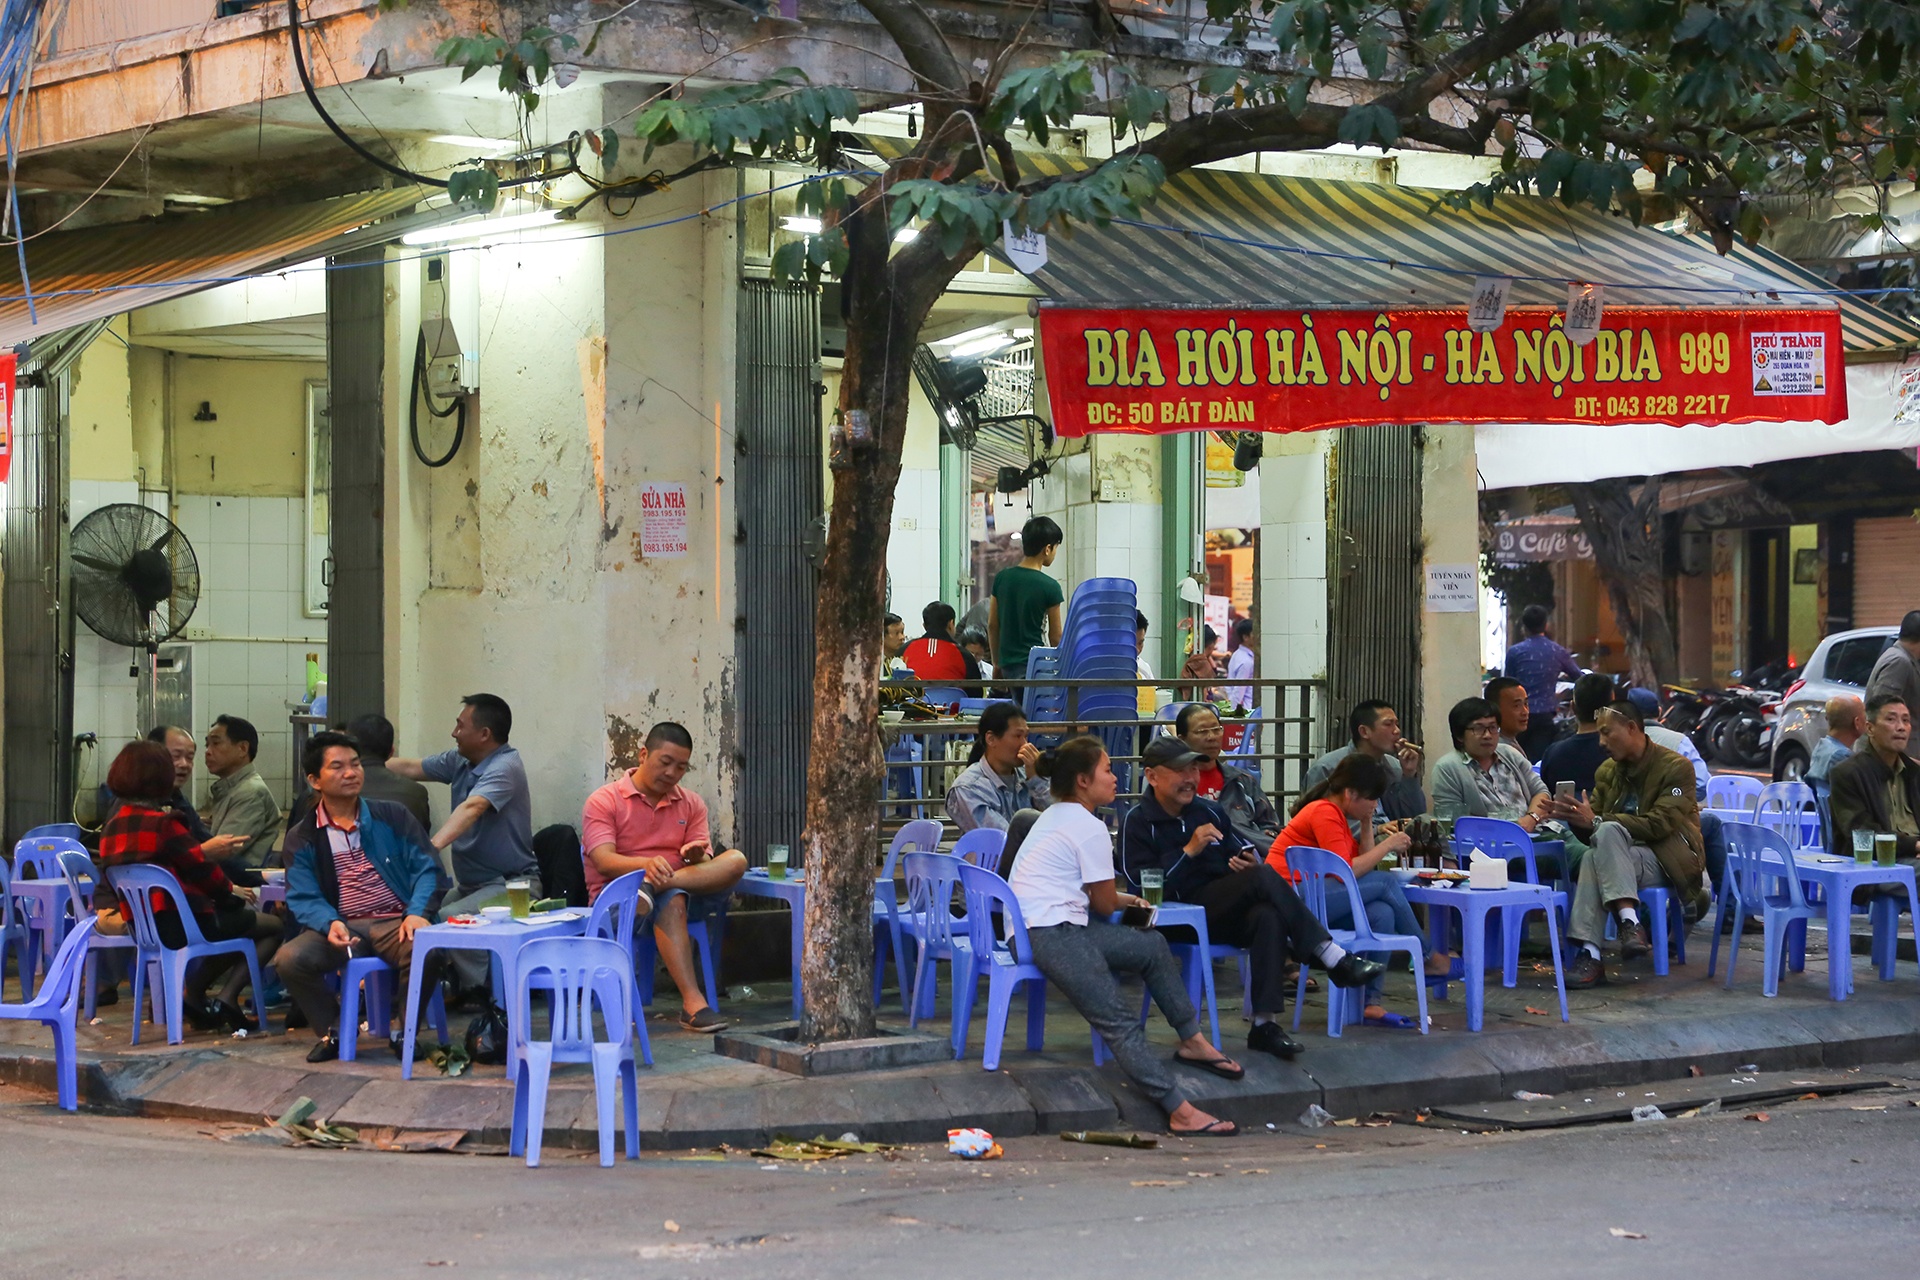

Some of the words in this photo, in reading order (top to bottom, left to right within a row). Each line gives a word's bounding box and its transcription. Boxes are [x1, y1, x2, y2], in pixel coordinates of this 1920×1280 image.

[1753, 333, 1777, 348] PHÚ
[1780, 333, 1822, 348] THÀNH
[1083, 328, 1166, 388] BIA
[1174, 318, 1257, 387] HƠI
[1265, 313, 1329, 386] HÀ
[1337, 312, 1413, 401] NỘI
[1514, 313, 1586, 399] NỘI
[1594, 328, 1662, 384] BIA
[1679, 332, 1730, 375] 989
[1087, 402, 1122, 425] ĐC:
[1128, 402, 1154, 424] 50
[1160, 397, 1202, 423] BÁT
[1208, 396, 1255, 423] ĐÀN
[1575, 398, 1601, 417] ĐT:
[1606, 397, 1638, 417] 043
[1645, 396, 1677, 416] 828
[1684, 395, 1730, 415] 2217
[642, 486, 661, 508] SỬA
[664, 488, 685, 508] NHÀ
[644, 543, 687, 552] 0983.195.194
